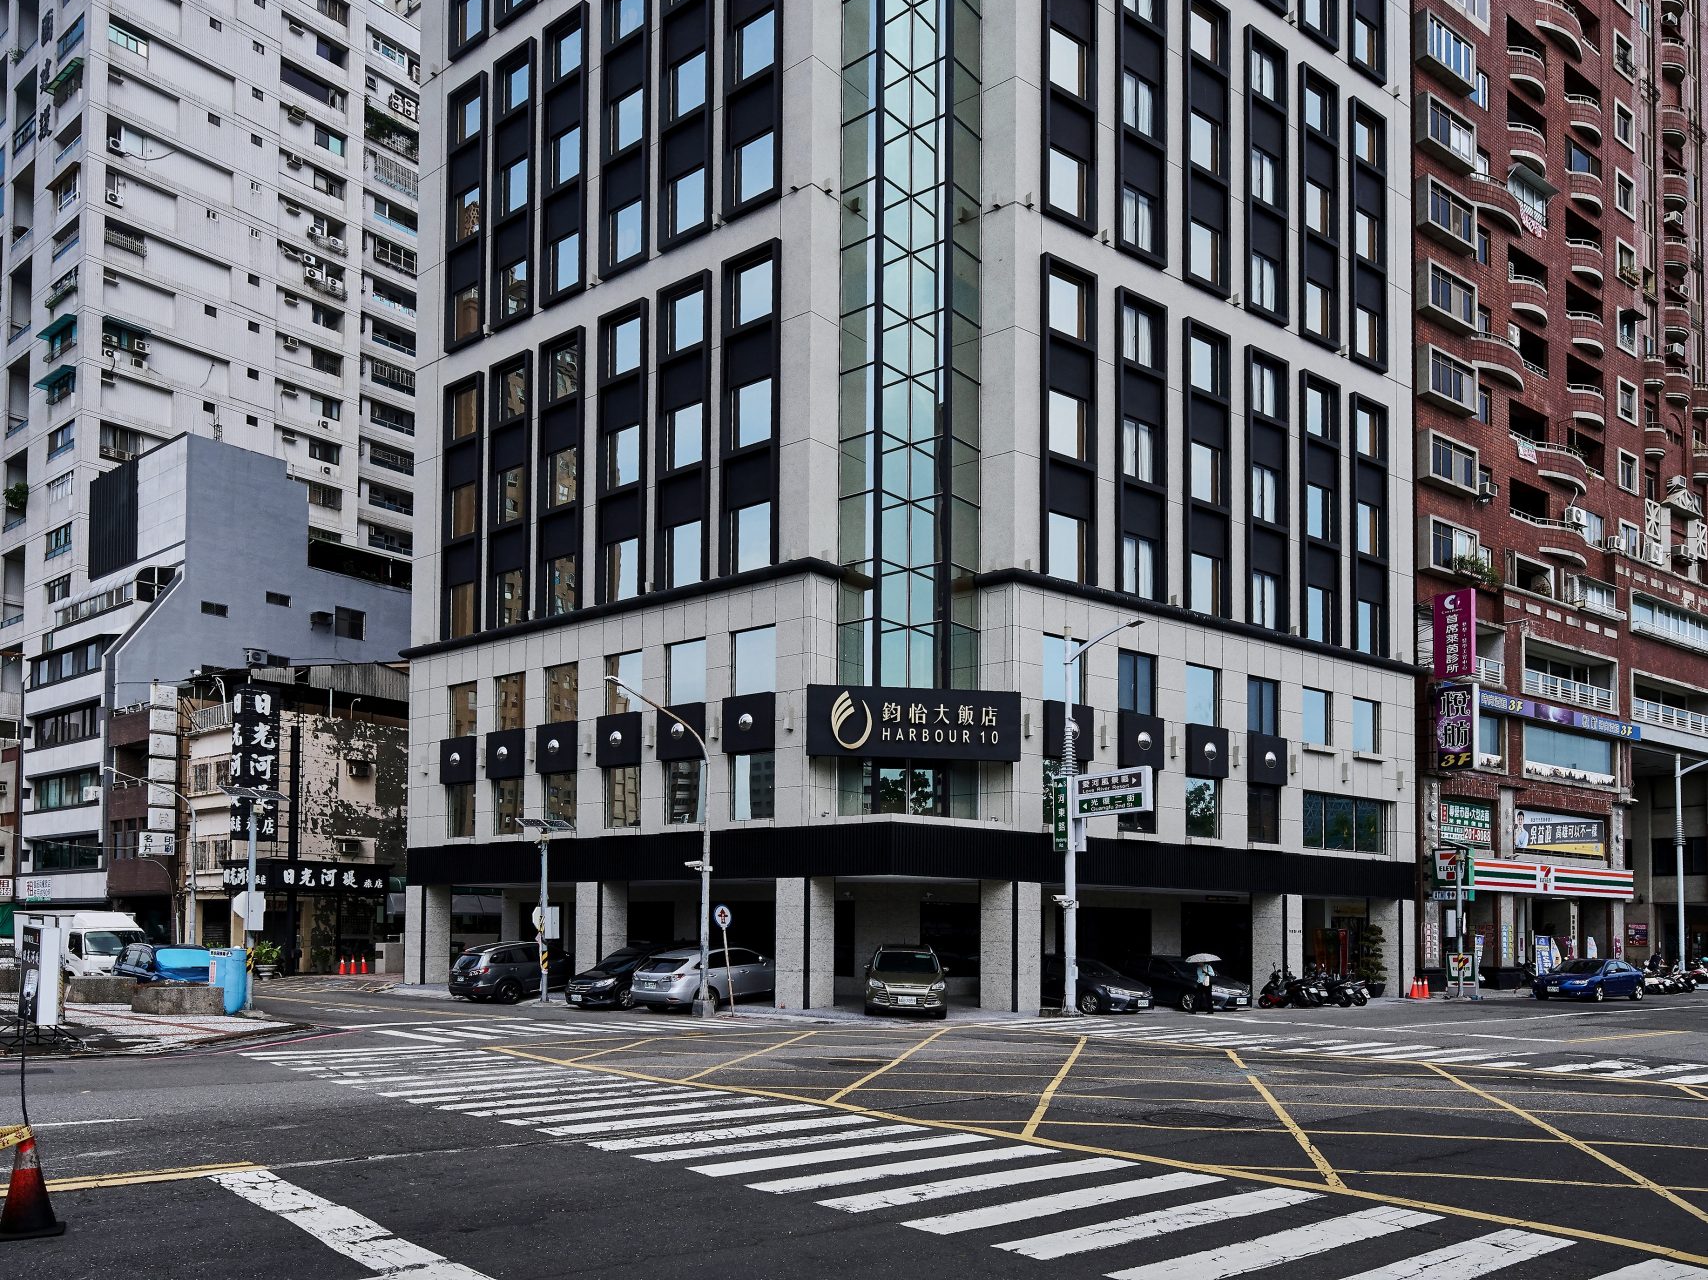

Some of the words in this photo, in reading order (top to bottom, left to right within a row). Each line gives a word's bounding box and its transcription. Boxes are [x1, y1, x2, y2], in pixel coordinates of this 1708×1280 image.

[1446, 614, 1459, 674] 首席萊茵診所
[882, 702, 998, 726] 鈞怡大飯店
[882, 727, 970, 743] HARBOUR
[980, 730, 999, 744] 10
[1440, 752, 1472, 767] 3F
[144, 834, 153, 852] 名片
[1530, 825, 1552, 844] 吳益政
[1555, 824, 1598, 839] 高雄可以不一樣
